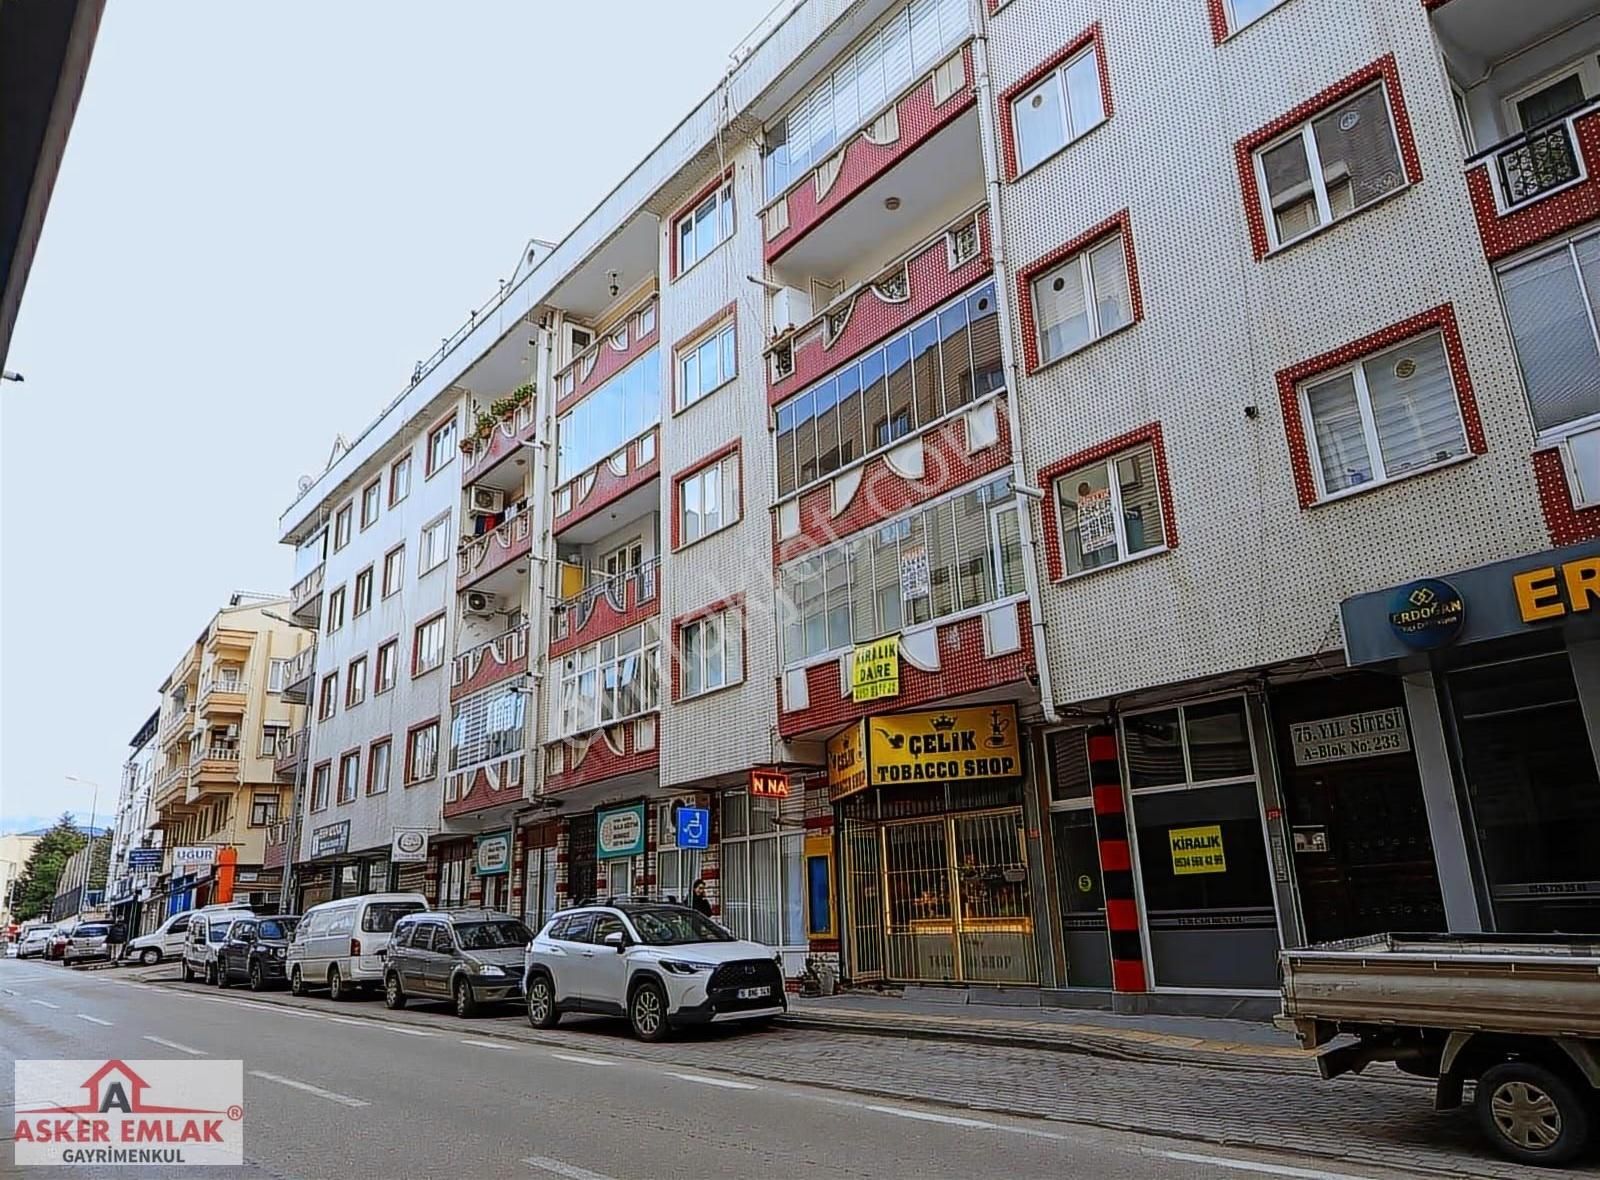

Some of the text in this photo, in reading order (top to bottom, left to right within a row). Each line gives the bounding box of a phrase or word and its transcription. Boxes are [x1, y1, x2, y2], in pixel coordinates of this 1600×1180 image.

[1304, 742, 1347, 760] A-Blok
[877, 757, 1014, 782] TOBACCO SHOP
[1172, 836, 1222, 851] KİRALIK
